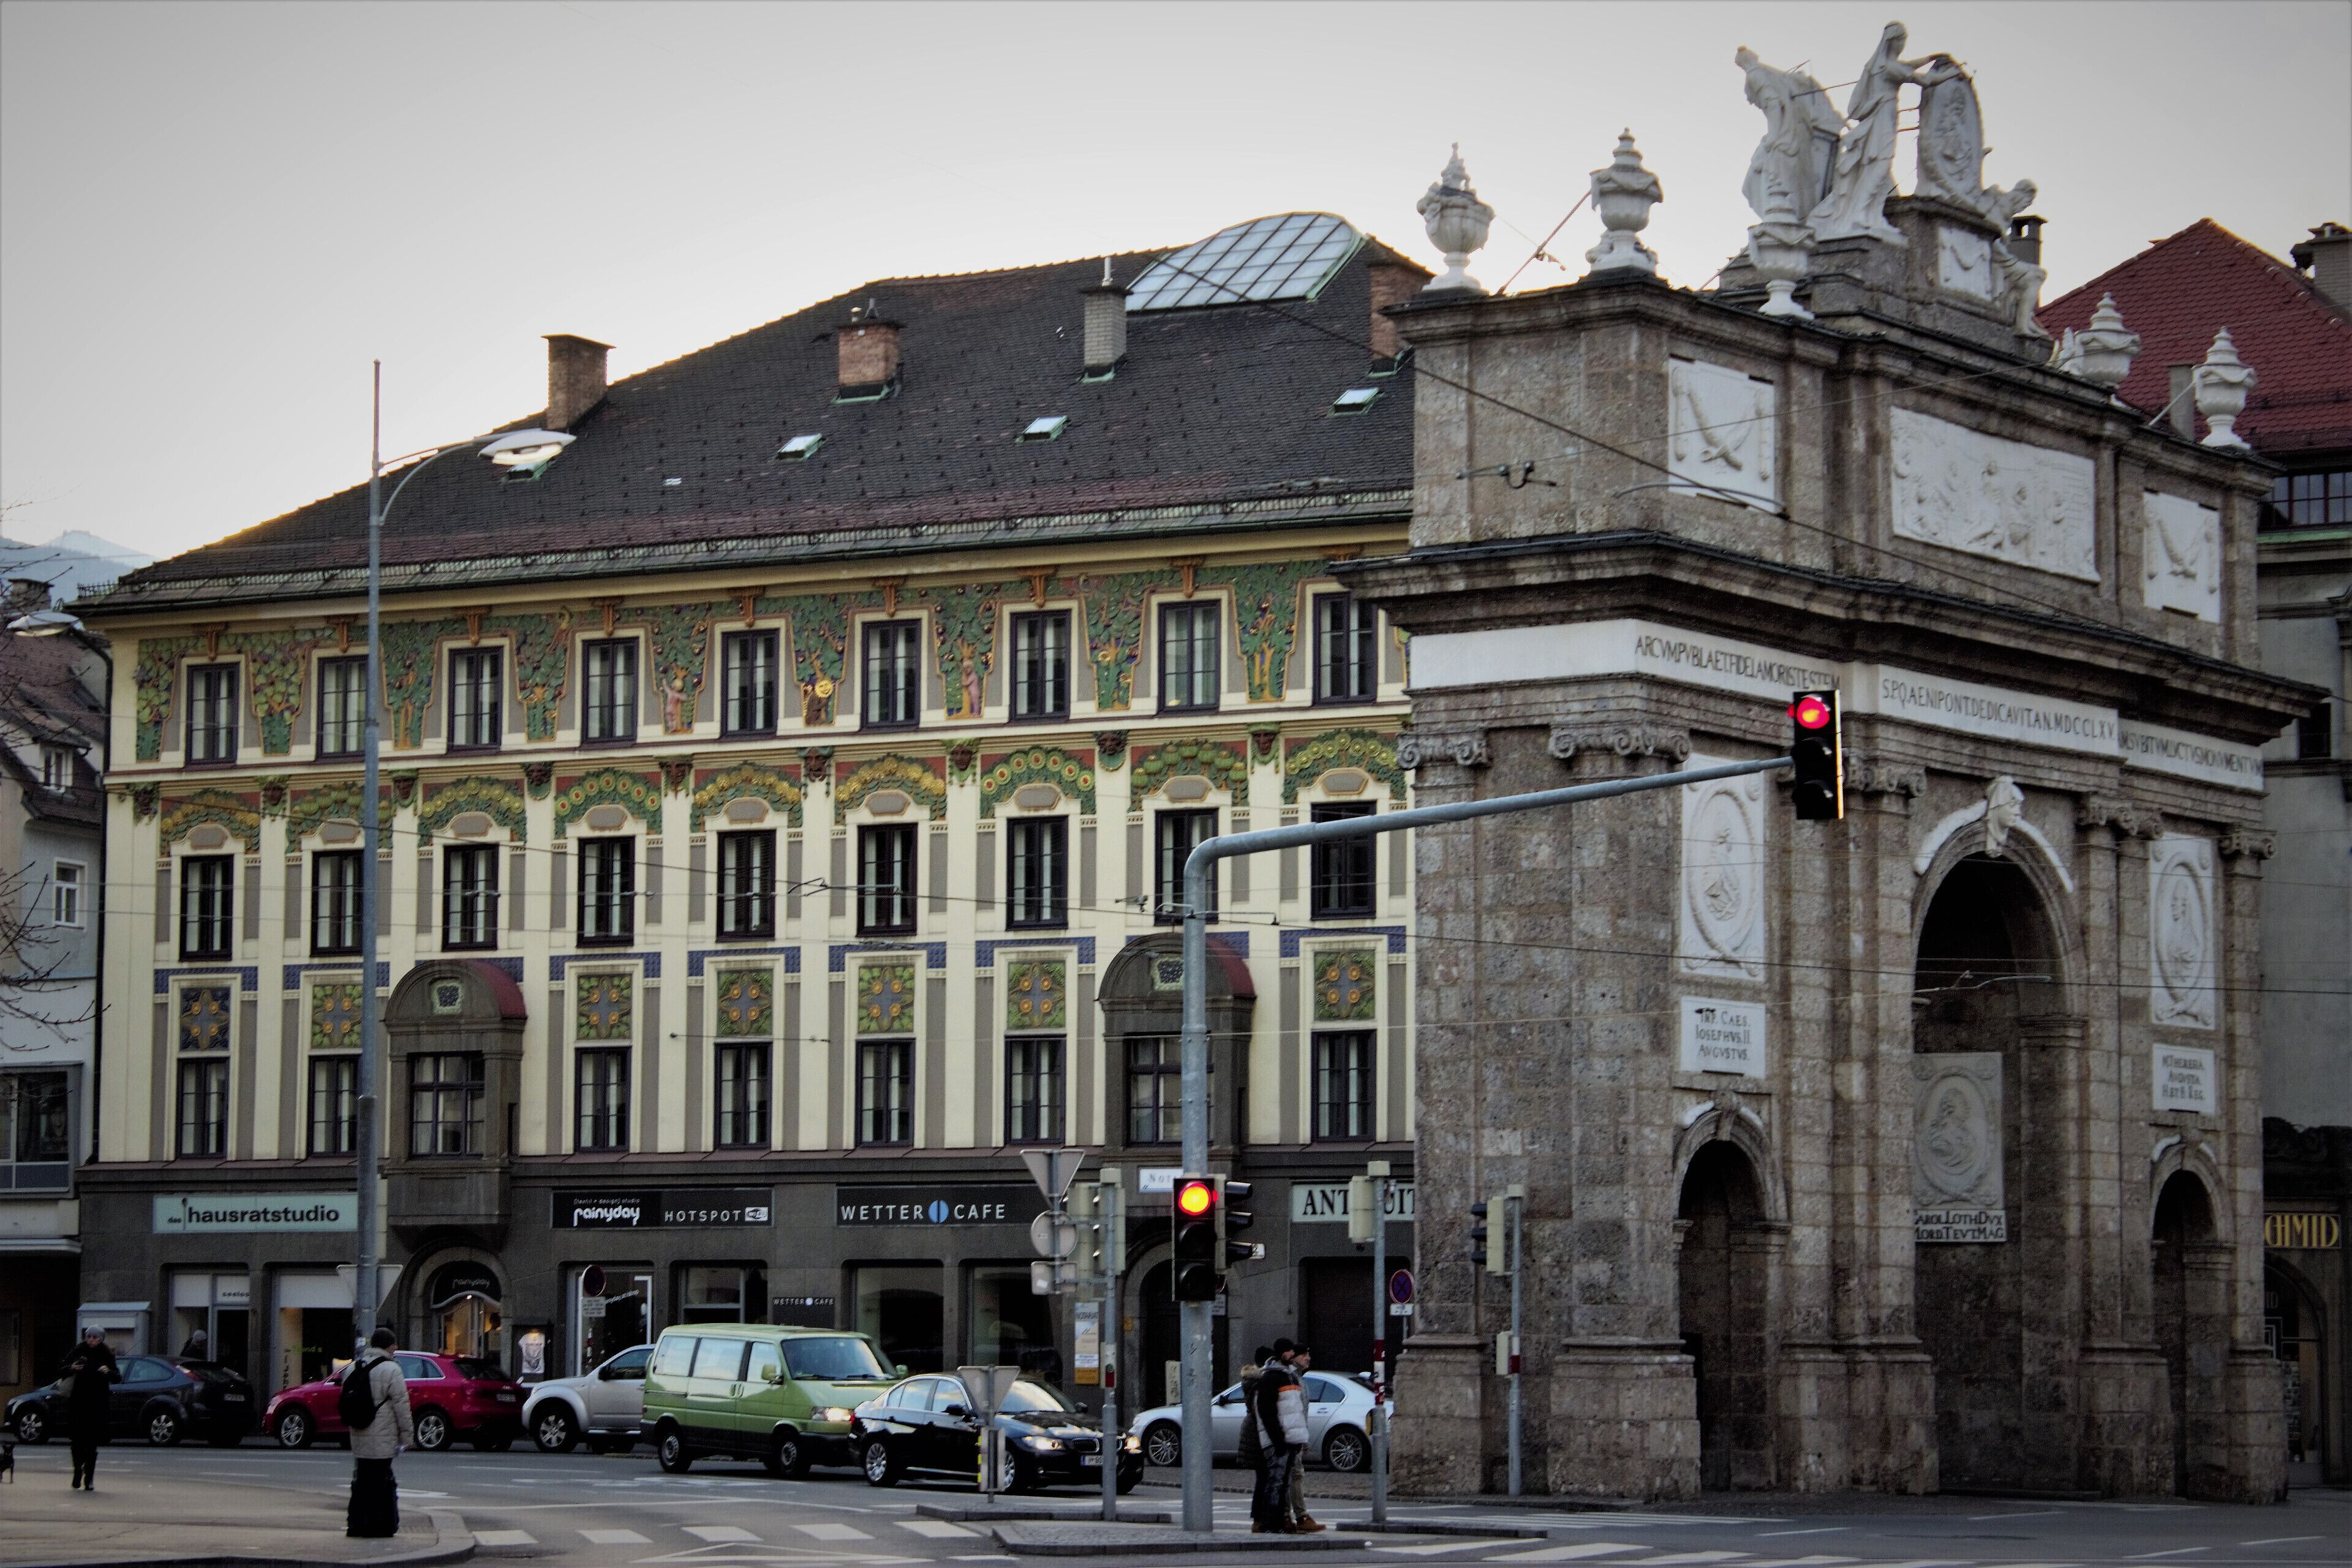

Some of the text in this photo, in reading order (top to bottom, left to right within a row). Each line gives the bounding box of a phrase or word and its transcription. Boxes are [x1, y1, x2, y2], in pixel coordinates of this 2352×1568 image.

[188, 1205, 339, 1223] hausratstudio
[573, 1205, 640, 1227] rainyday
[665, 1210, 741, 1222] HOTSPOT
[840, 1204, 1005, 1220] WETTER CAFE
